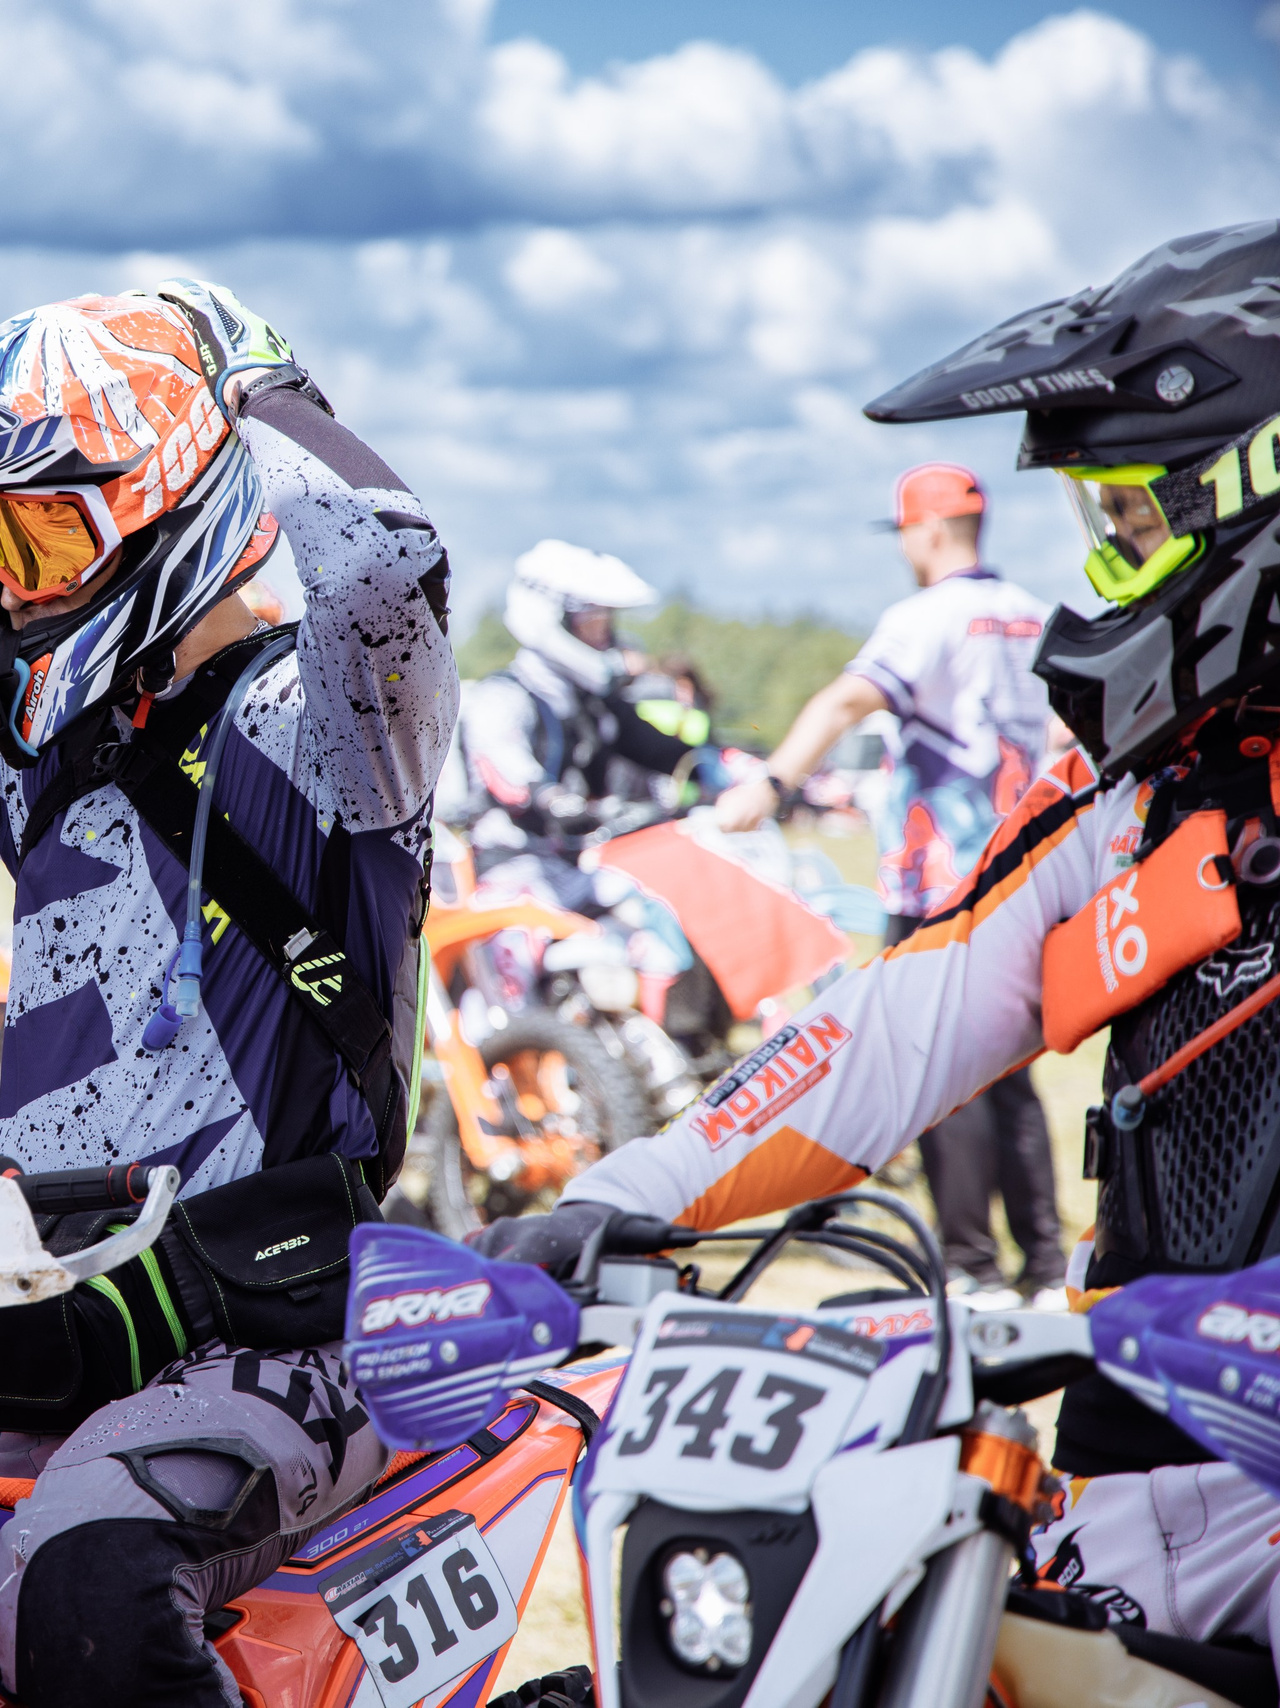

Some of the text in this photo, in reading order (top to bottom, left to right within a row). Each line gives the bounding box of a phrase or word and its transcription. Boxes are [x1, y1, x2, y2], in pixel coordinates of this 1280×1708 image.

[960, 384, 1024, 411] GOOD
[24, 668, 46, 723] Airoh
[696, 1014, 847, 1145] NAIKOM
[618, 1366, 827, 1472] 343
[306, 1526, 349, 1560] 300
[353, 1548, 499, 1684] 316
